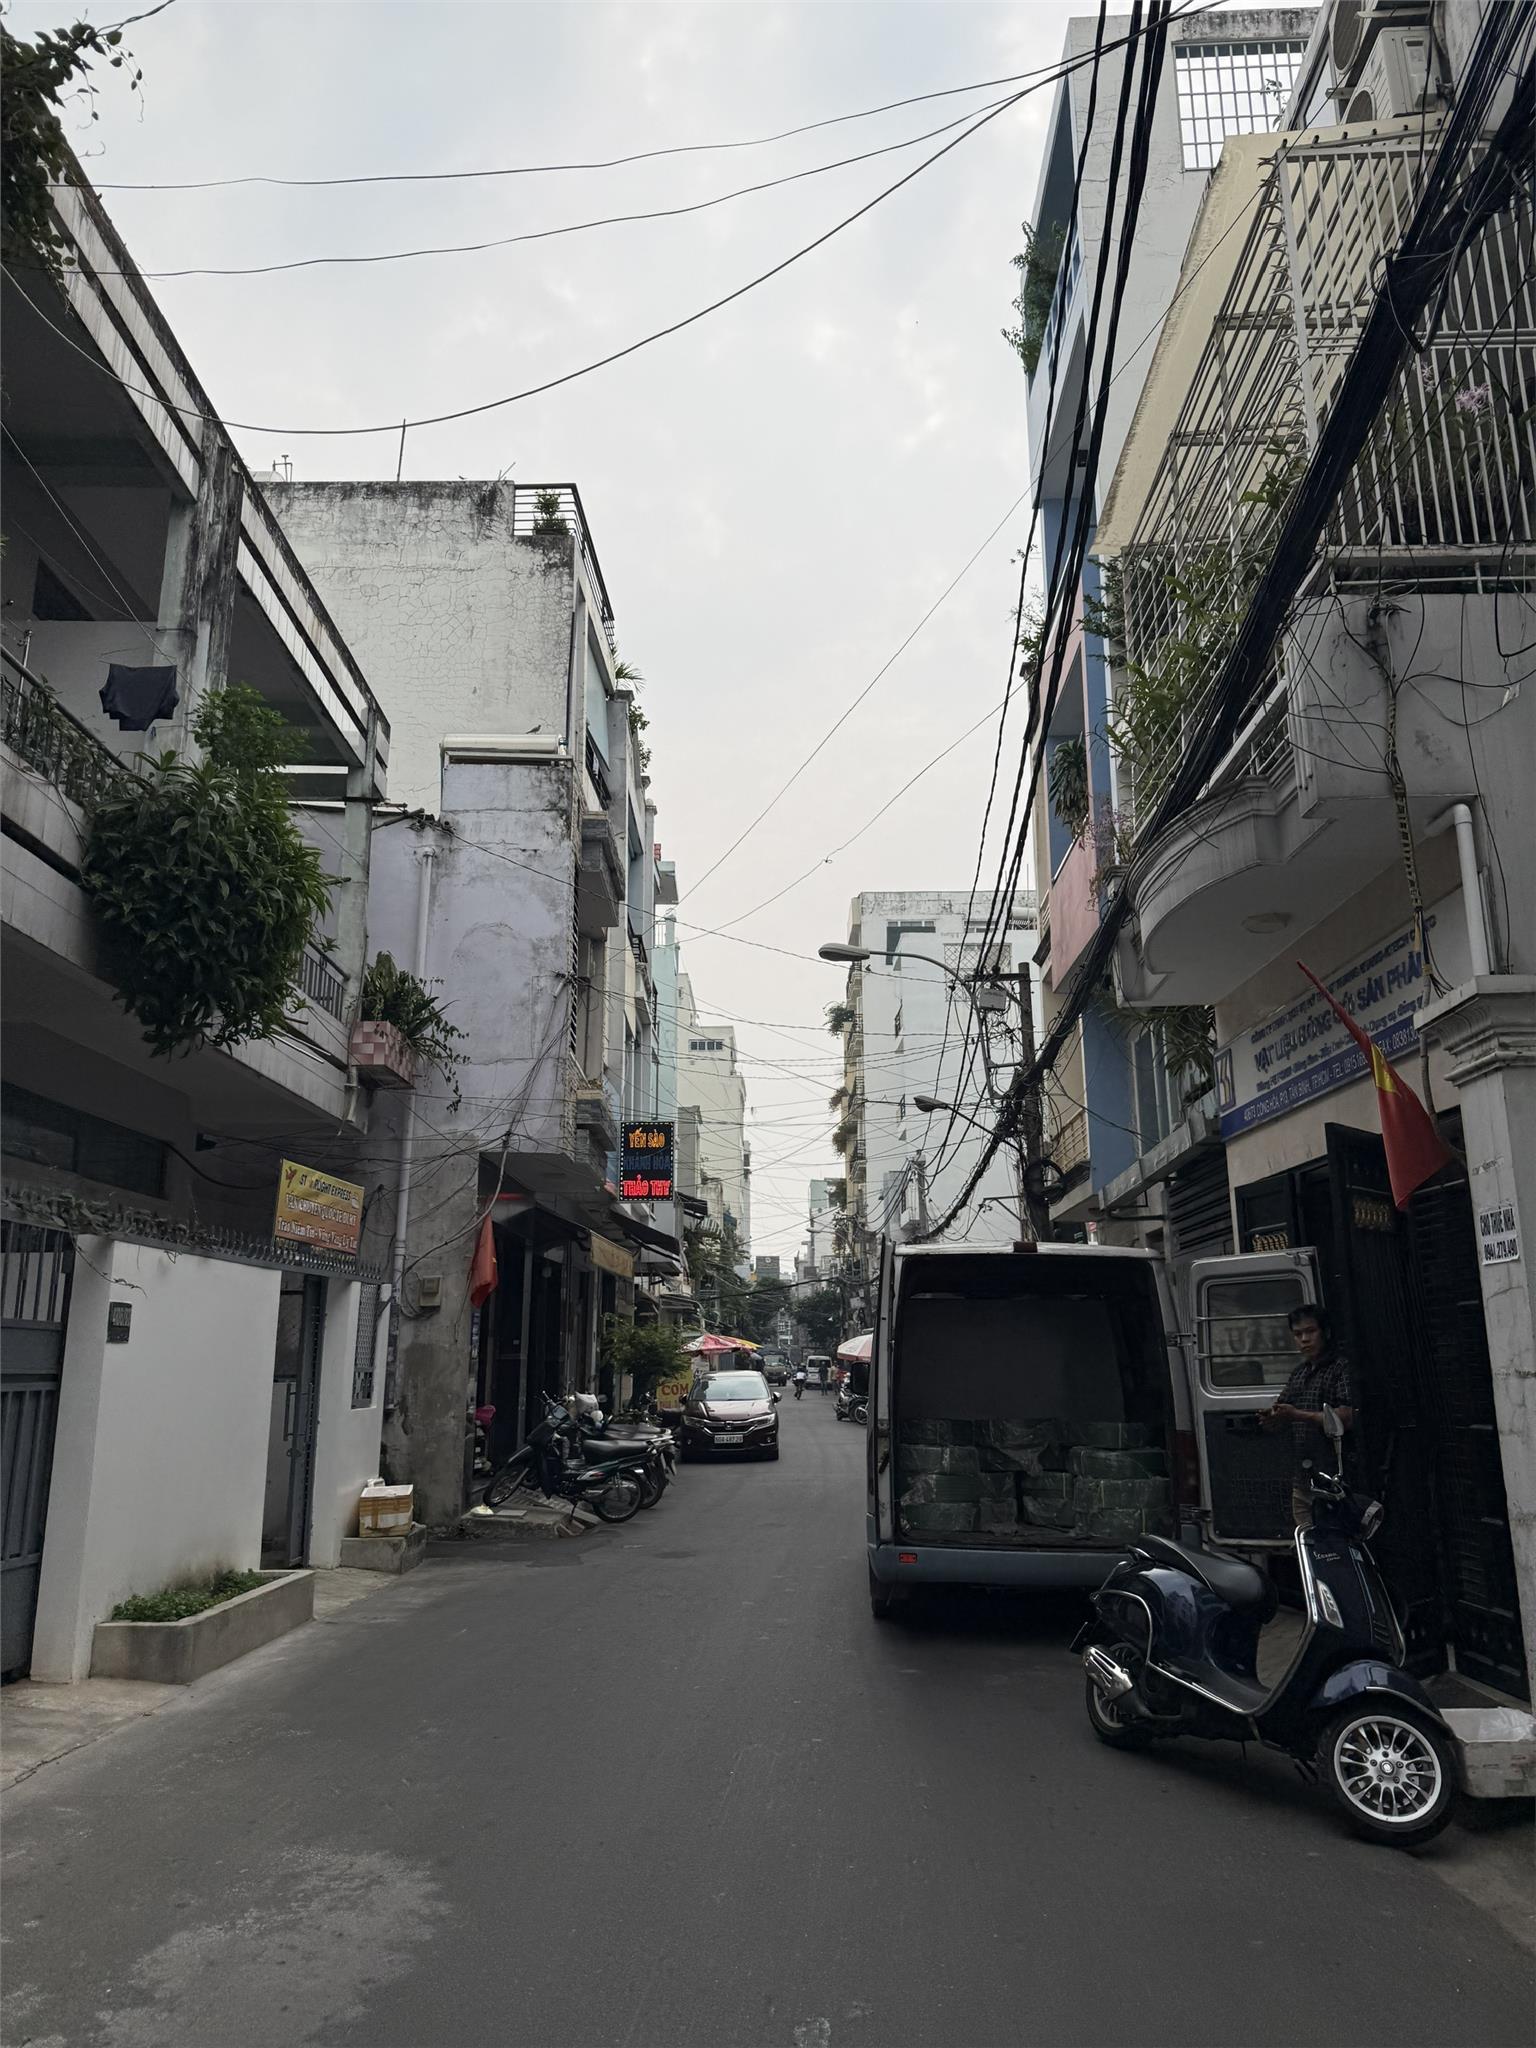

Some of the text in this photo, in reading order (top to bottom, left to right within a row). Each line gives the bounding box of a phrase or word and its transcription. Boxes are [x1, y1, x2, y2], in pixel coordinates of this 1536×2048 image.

[629, 1127, 646, 1148] YẾN
[331, 1185, 351, 1200] EXPRESS
[623, 1174, 649, 1196] THẢO
[1480, 1213, 1490, 1236] CHO
